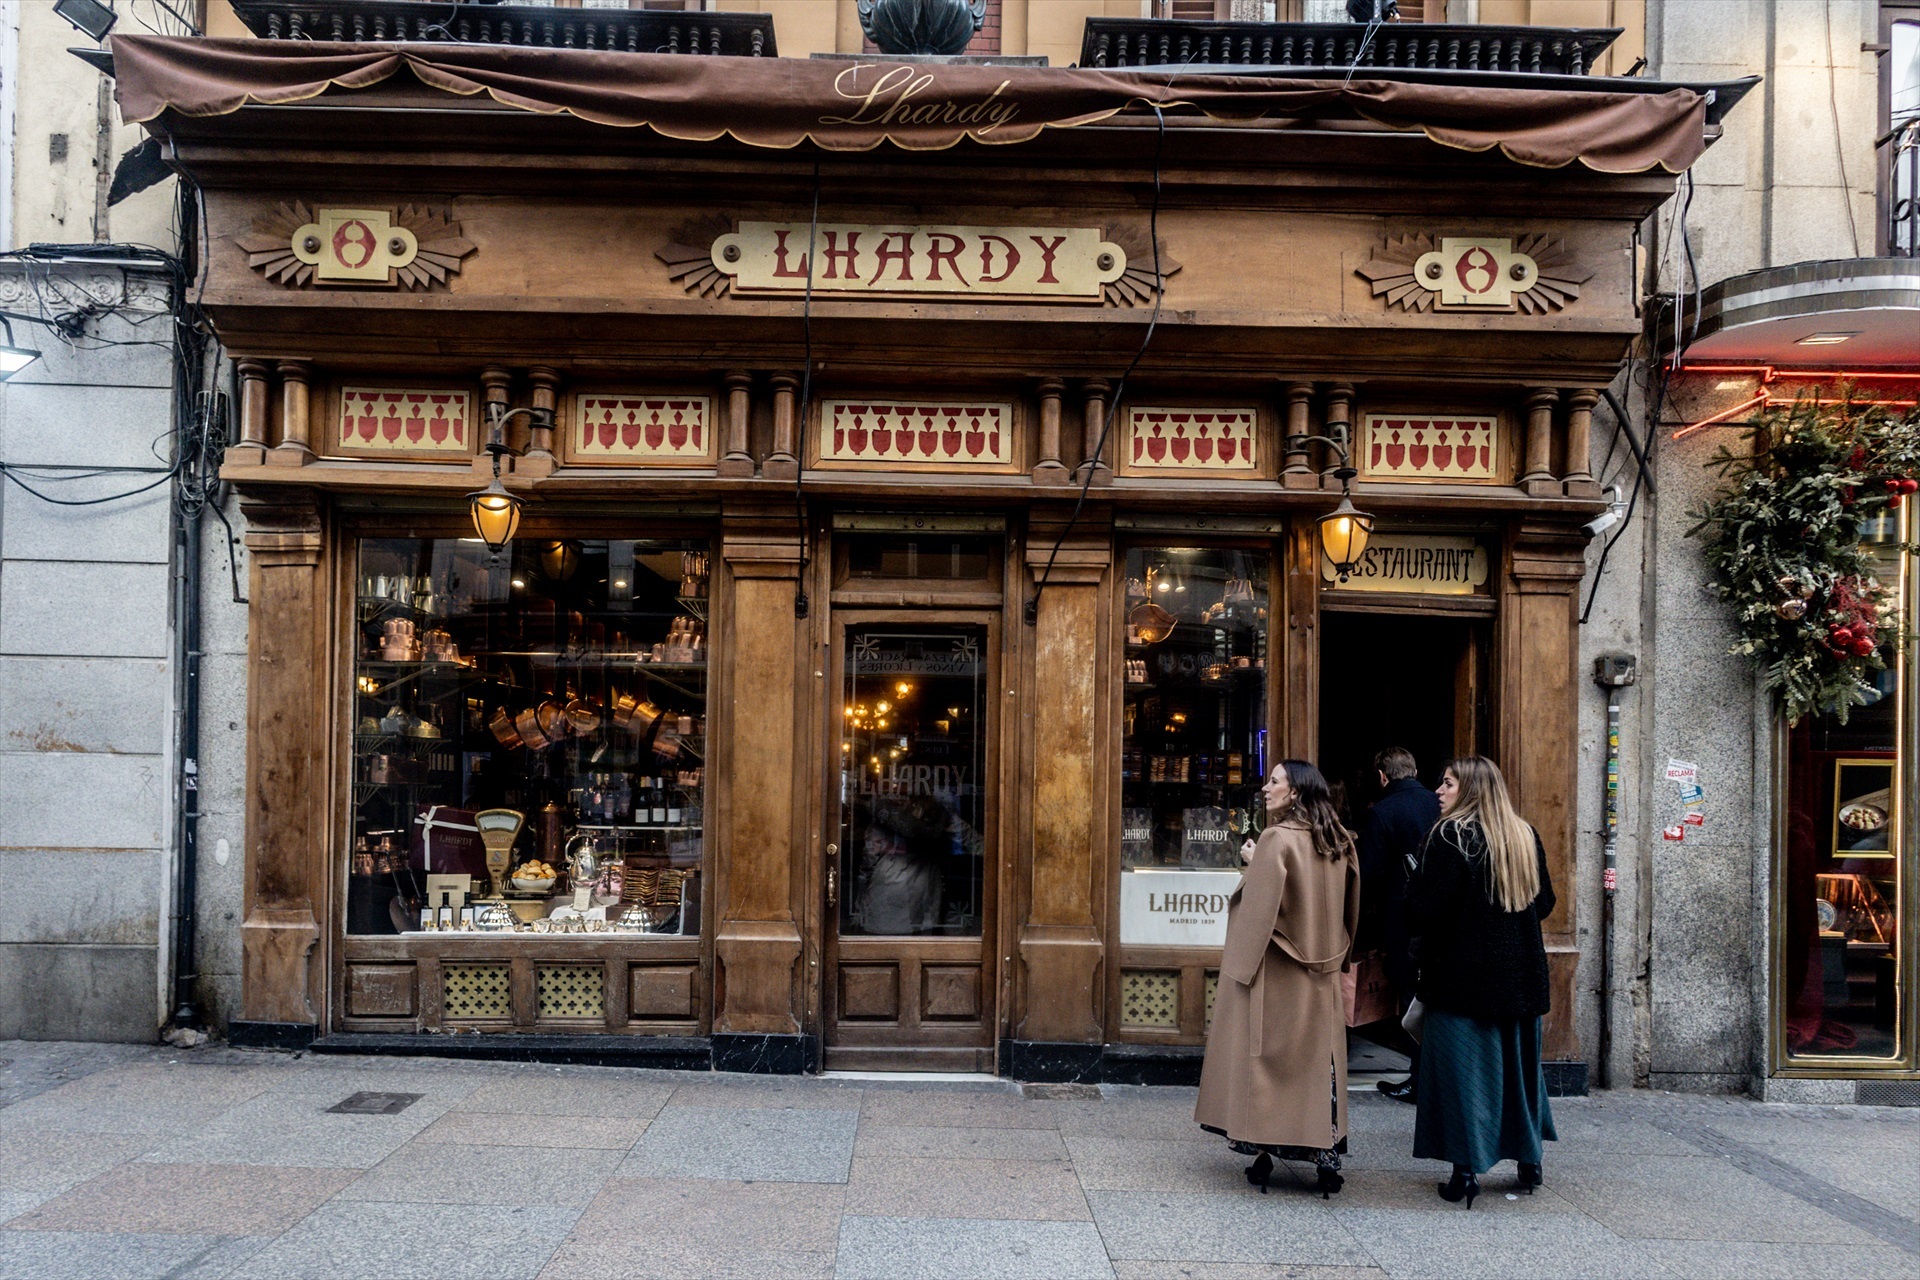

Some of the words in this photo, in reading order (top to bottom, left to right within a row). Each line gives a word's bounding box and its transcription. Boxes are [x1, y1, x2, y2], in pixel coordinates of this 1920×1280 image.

[818, 64, 1021, 136] Lhardy
[332, 220, 377, 269] 8
[772, 229, 1067, 287] LHARDY
[1455, 246, 1499, 294] 8
[859, 764, 968, 796] LHARDY
[1667, 769, 1695, 778] RECLAMA
[1187, 829, 1229, 842] LHARDY
